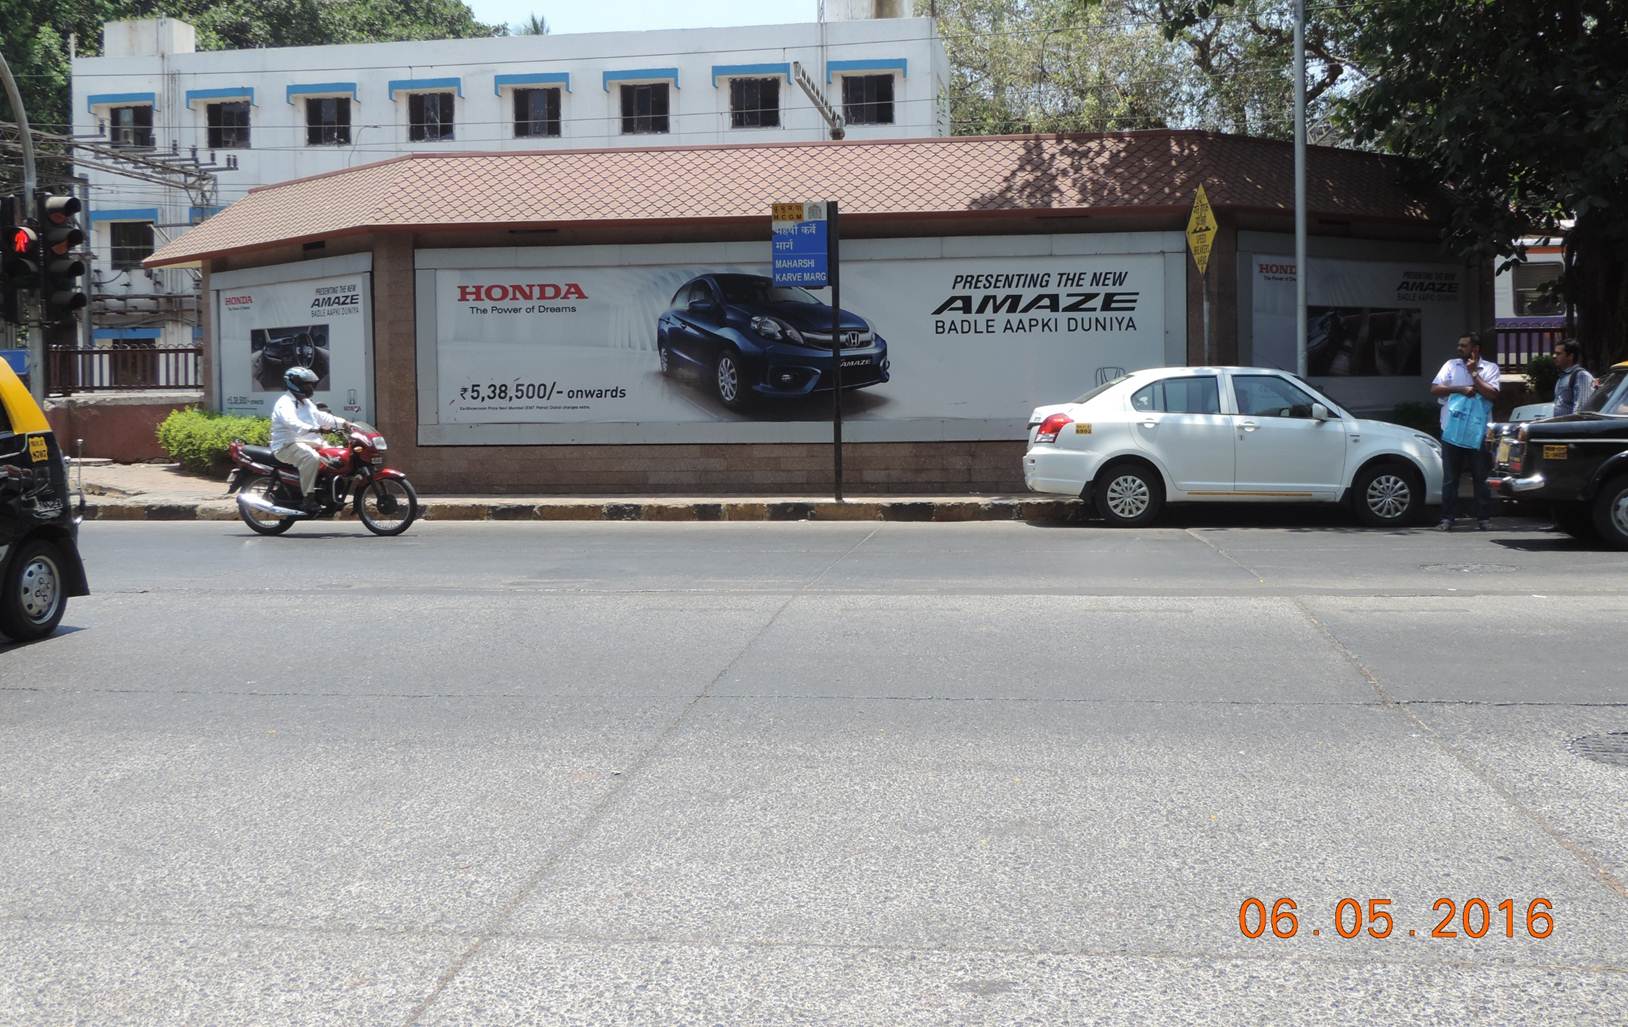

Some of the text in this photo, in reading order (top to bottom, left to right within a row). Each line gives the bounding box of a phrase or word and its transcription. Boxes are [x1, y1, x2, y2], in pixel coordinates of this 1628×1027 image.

[775, 259, 816, 269] MAHARSHI
[1258, 263, 1297, 275] HOND
[775, 272, 827, 282] KARVE MARG
[952, 271, 1129, 290] PRESENTING THE NEW
[457, 283, 589, 302] HONDA
[1396, 281, 1460, 293] AMAZE
[224, 296, 253, 306] HONDA
[310, 294, 360, 308] AMAZE
[931, 292, 1140, 316] AMAZE
[470, 304, 577, 315] The Power of Dreams
[935, 317, 1137, 334] BADLE AAPKI DUNIYA
[840, 359, 872, 367] AMAZE
[460, 382, 627, 402] ₹5,38,500/- onwards
